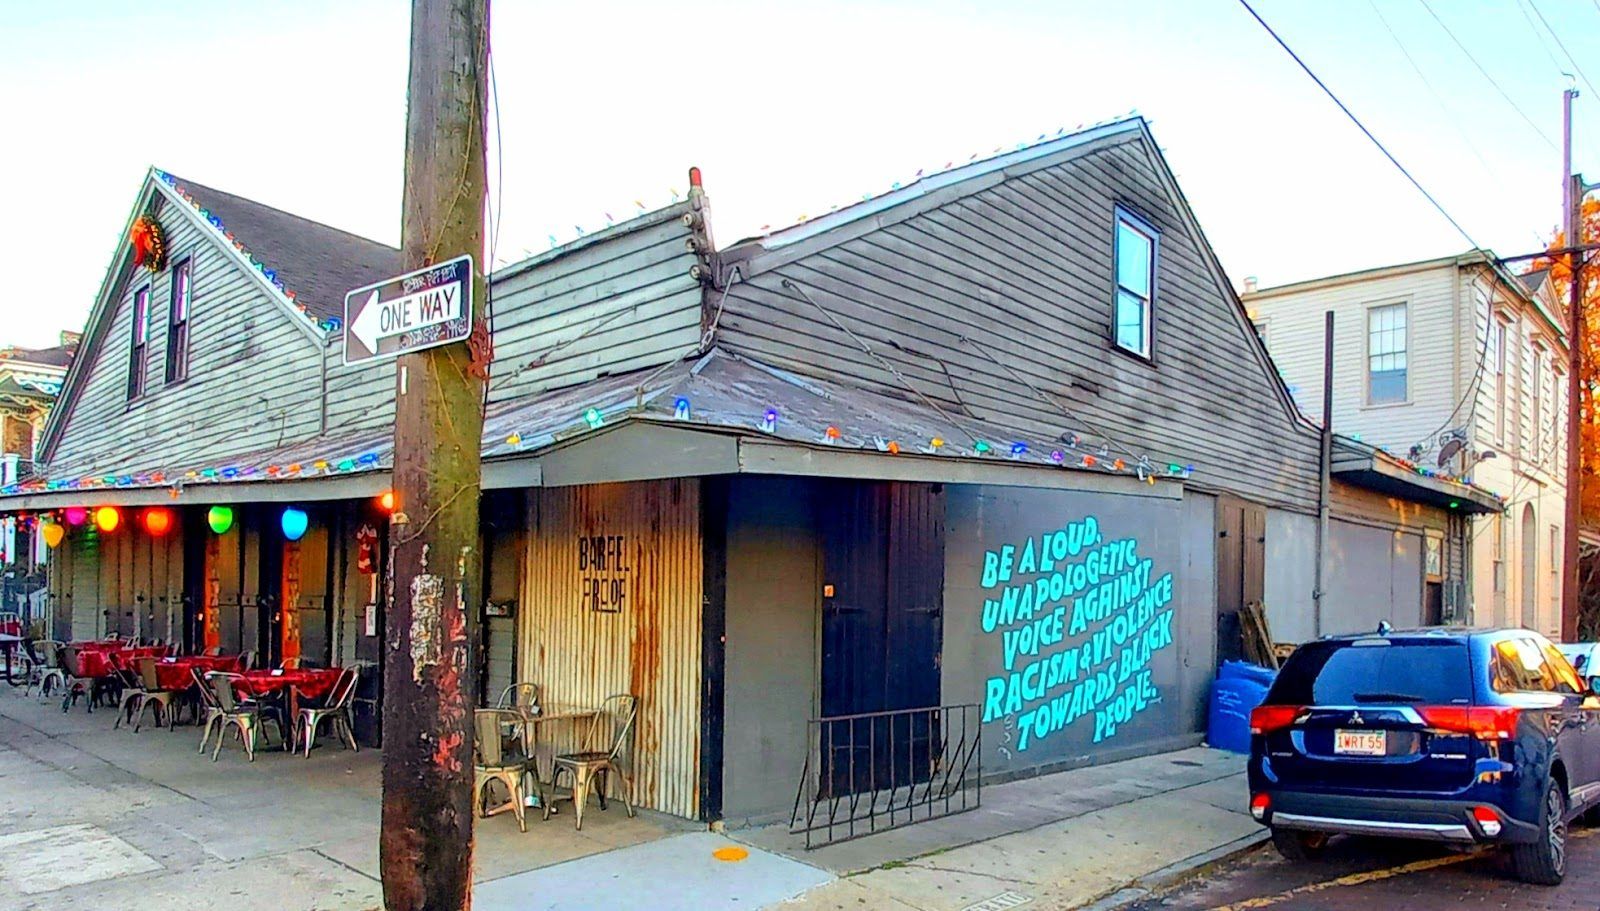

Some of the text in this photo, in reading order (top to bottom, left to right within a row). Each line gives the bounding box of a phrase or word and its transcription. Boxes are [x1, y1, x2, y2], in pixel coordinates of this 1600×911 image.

[380, 299, 412, 333] ONE
[420, 286, 456, 323] WAY
[981, 544, 1015, 588] BE
[1018, 536, 1036, 574] A
[981, 539, 1137, 633] UNAPOLOGETIC
[982, 648, 1079, 723] RACISM
[1092, 573, 1172, 665] VIOLENCE
[1003, 559, 1152, 670] VOICE AGAINST
[1016, 609, 1173, 751] TOWARDS BLACK
[1093, 669, 1157, 743] PEOPLE.
